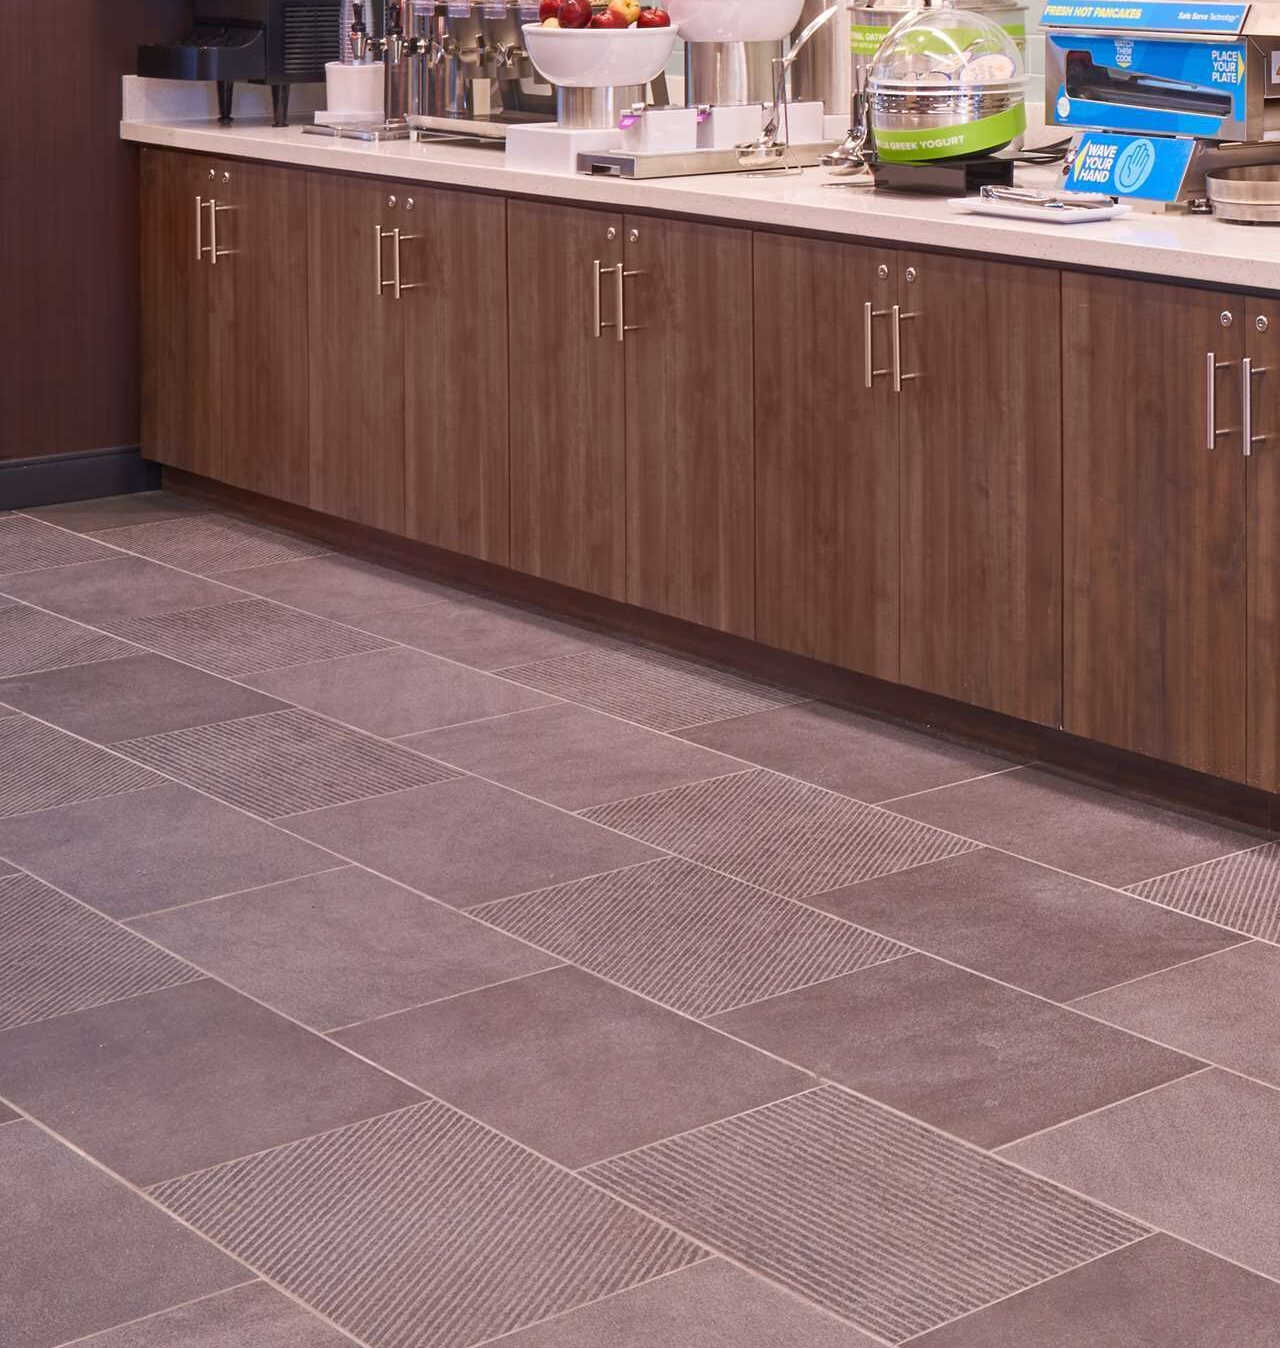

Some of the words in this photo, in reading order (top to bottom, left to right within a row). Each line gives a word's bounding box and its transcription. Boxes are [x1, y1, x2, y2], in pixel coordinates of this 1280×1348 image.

[1044, 5, 1074, 17] FRESH
[1073, 6, 1096, 18] HOT
[1093, 7, 1143, 20] PANCAKES
[1211, 50, 1238, 62] PLACE
[1212, 61, 1236, 73] YOUR
[1211, 71, 1237, 84] PLATE
[920, 135, 965, 149] YOGURT
[1087, 143, 1118, 158] WAVE
[1084, 155, 1114, 171] YOUR
[1078, 168, 1110, 183] HAND
